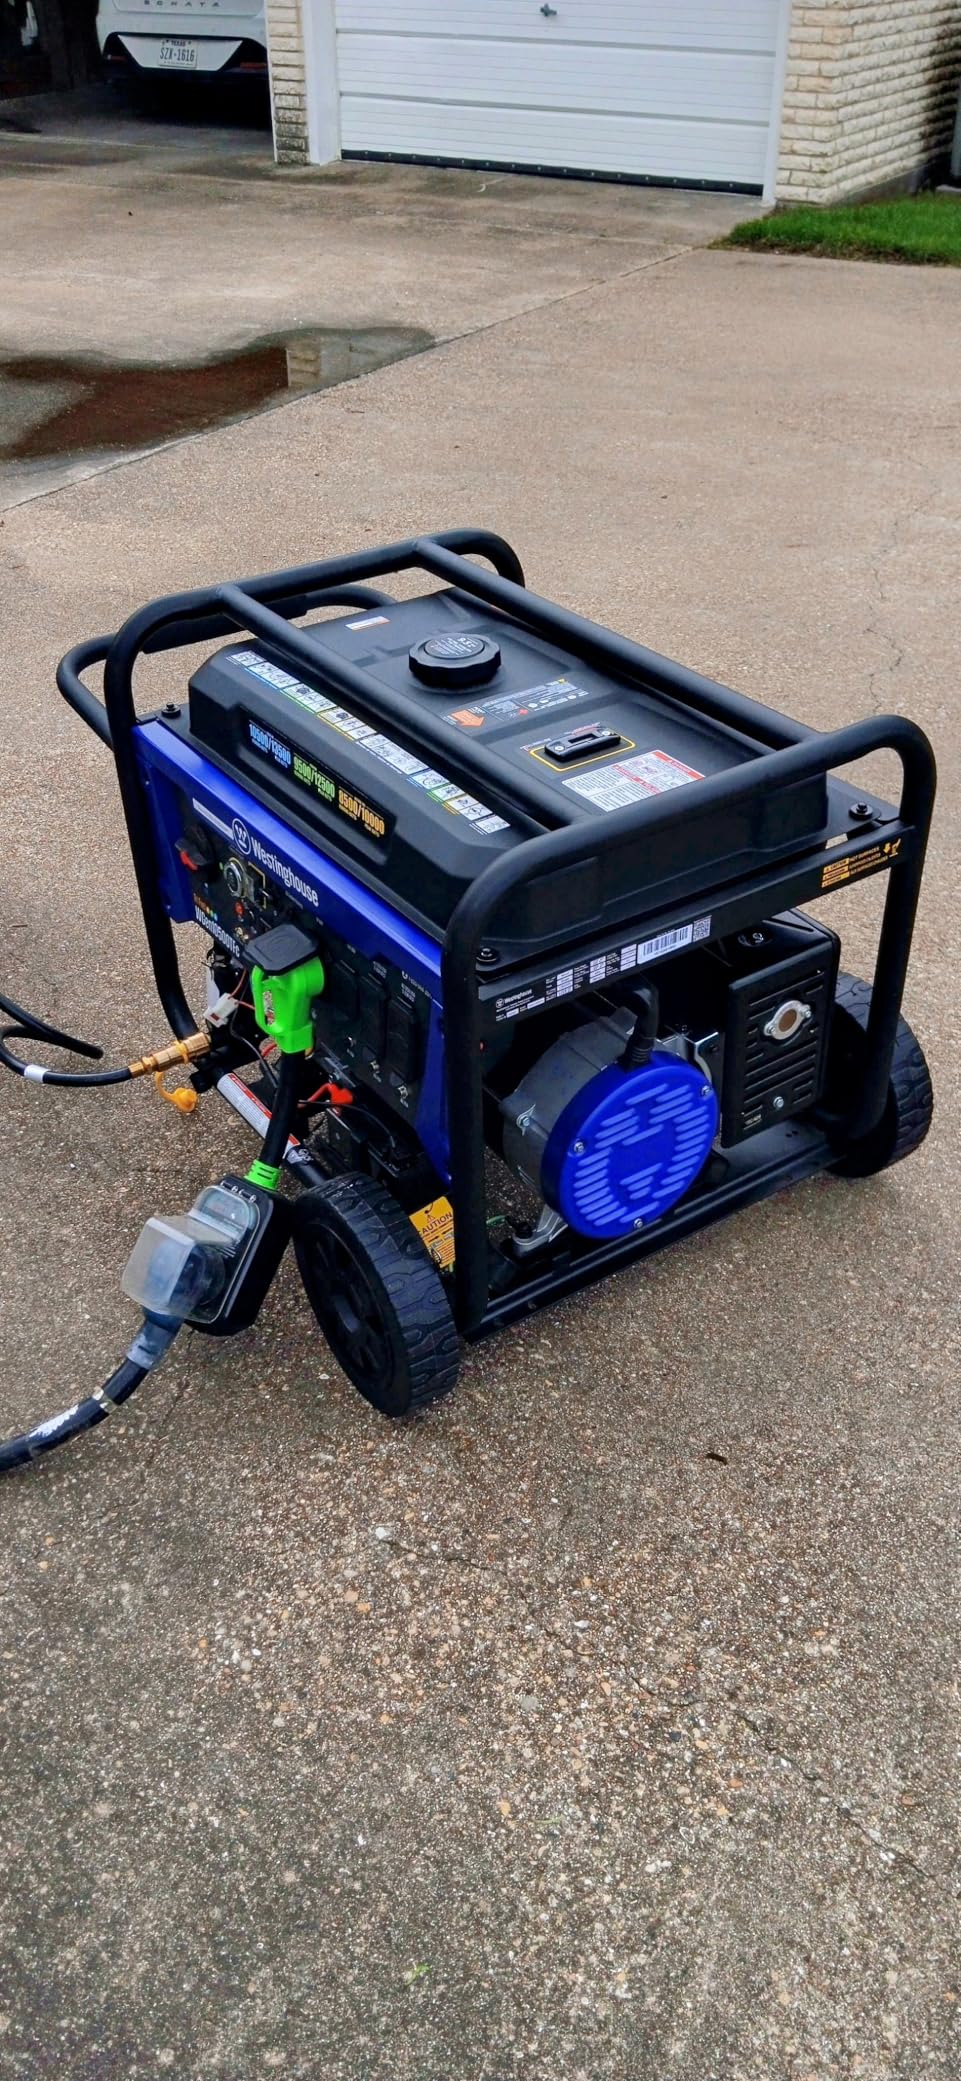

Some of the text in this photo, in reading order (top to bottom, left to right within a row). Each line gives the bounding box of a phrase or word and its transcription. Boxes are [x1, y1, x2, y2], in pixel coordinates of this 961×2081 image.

[293, 754, 336, 799] 9500/12500
[251, 837, 319, 907] Westinghouse
[419, 1211, 453, 1234] AUTION
